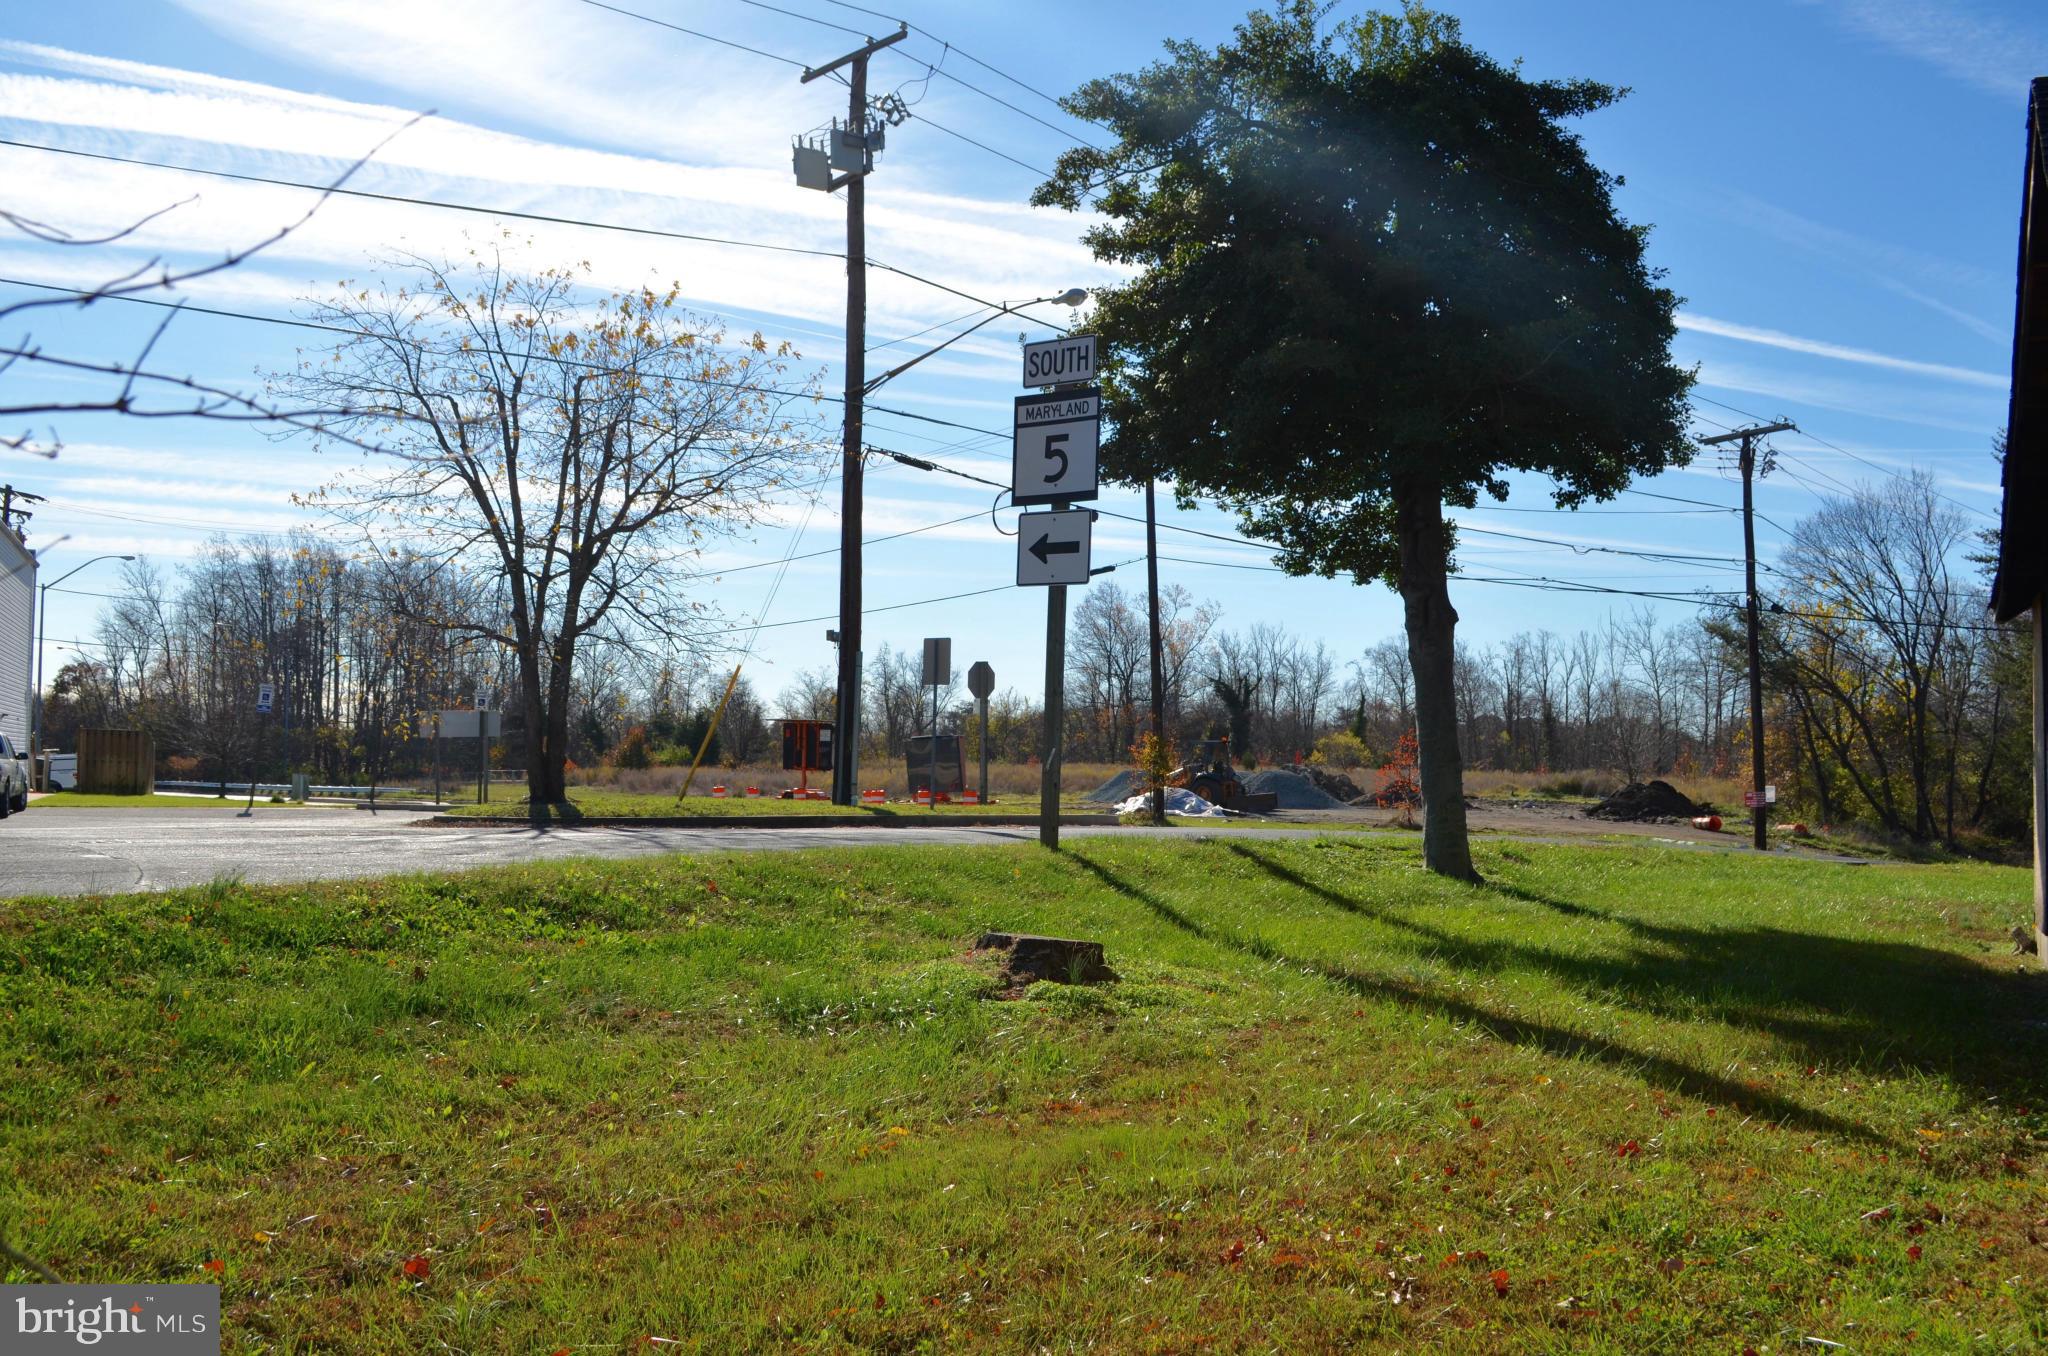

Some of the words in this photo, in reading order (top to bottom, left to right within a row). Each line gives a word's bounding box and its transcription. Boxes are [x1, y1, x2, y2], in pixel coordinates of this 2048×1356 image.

[1028, 344, 1090, 378] SOUTH
[1025, 400, 1090, 421] MARYLAND
[1043, 433, 1070, 484] 5
